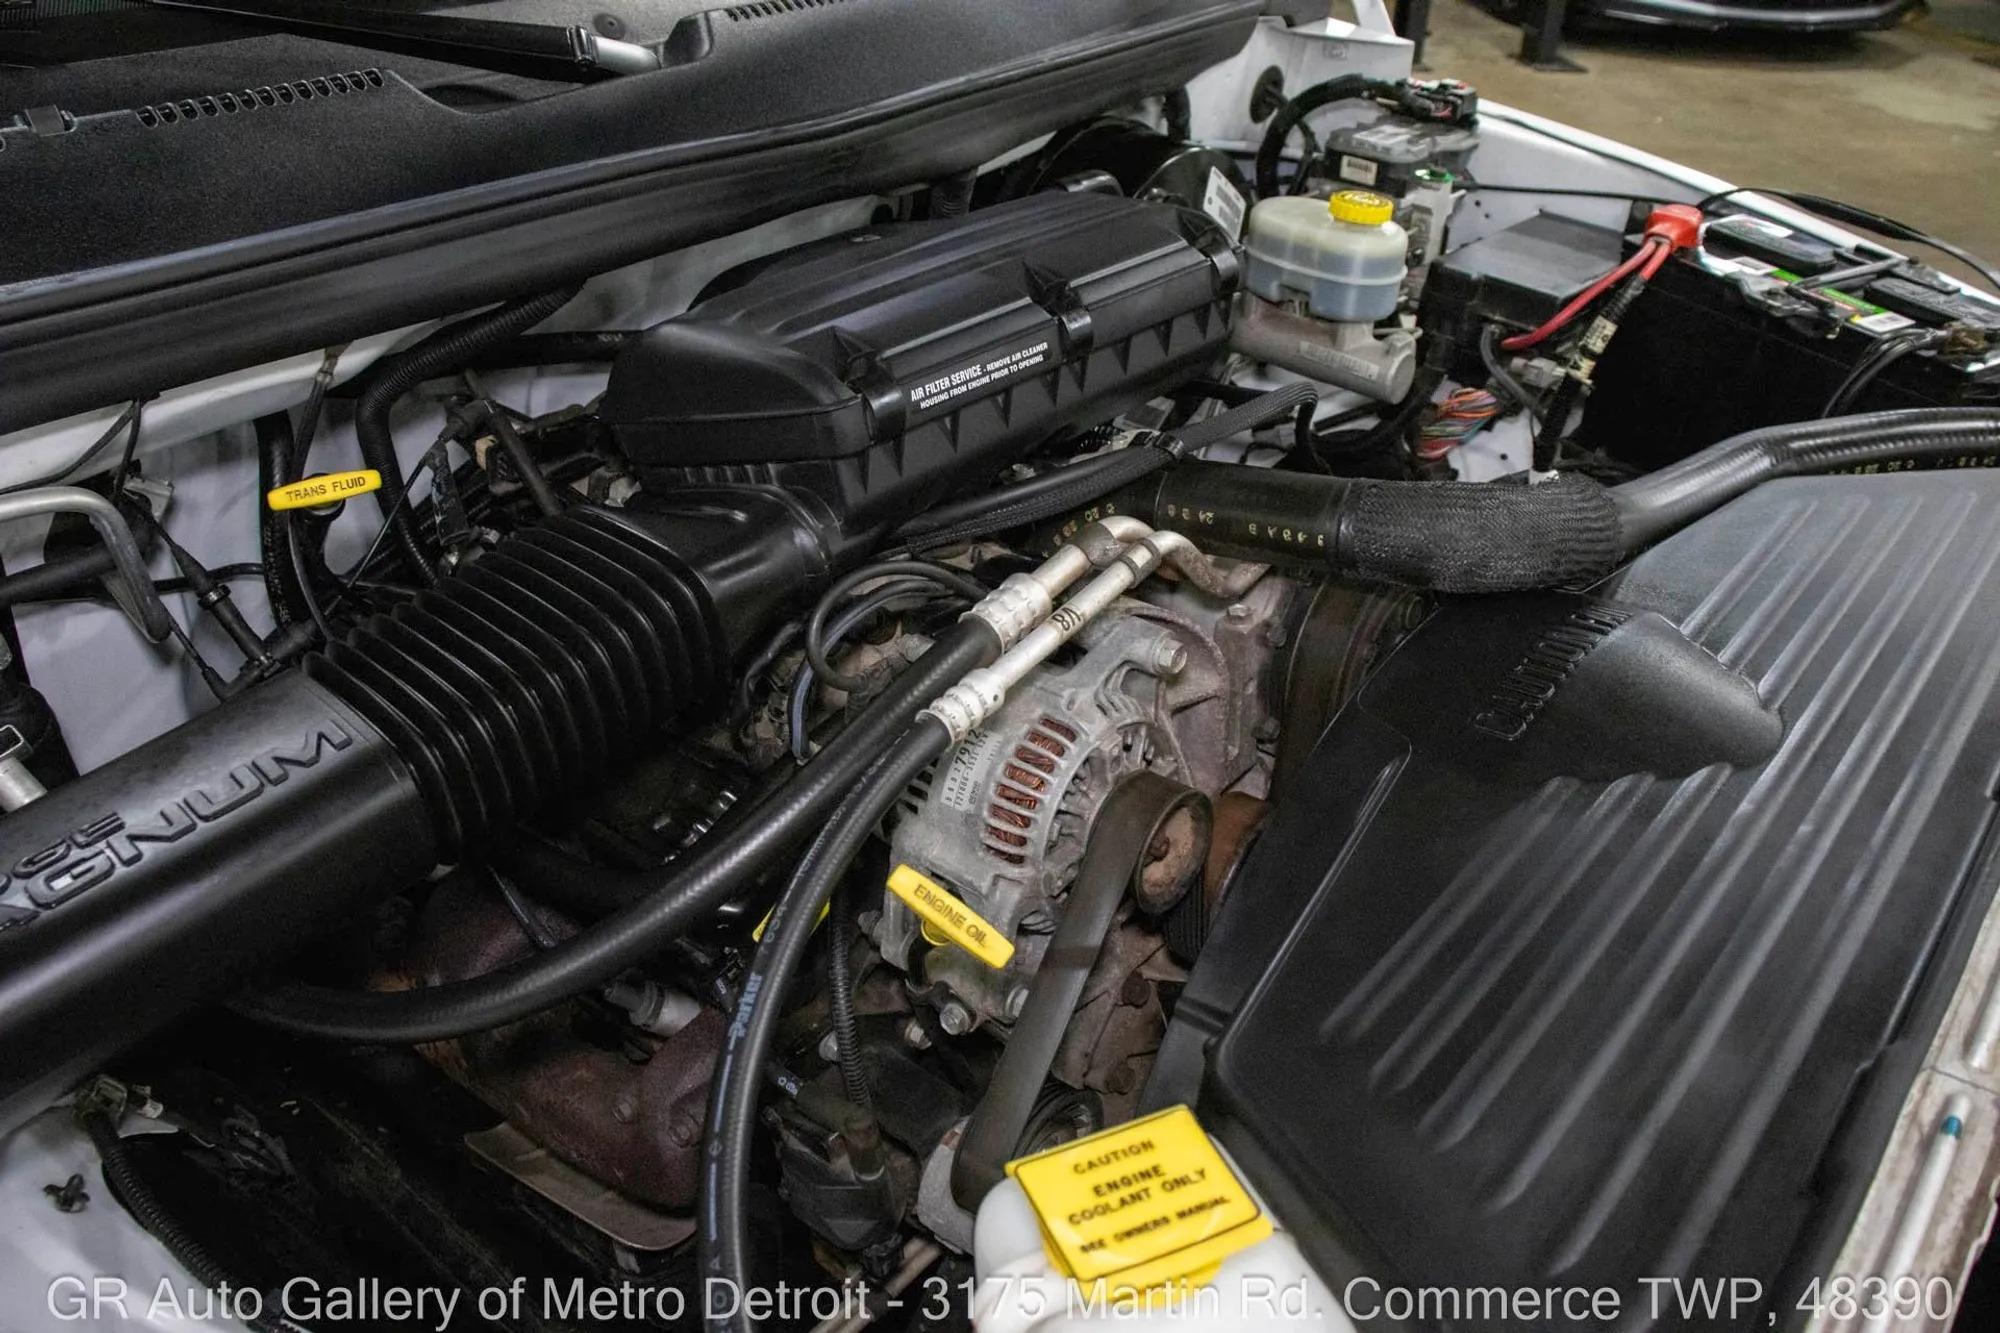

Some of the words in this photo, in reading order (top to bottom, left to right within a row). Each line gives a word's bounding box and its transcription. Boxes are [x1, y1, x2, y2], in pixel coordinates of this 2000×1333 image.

[910, 389, 924, 402] AIR
[925, 376, 951, 395] FILTER
[951, 364, 982, 386] SERVICE
[986, 358, 1011, 372] REMOVE
[1011, 351, 1022, 362] AIR
[1021, 341, 1048, 358] CLEANER
[920, 393, 949, 410] HOUSING
[949, 385, 968, 398] FROM
[968, 375, 990, 390] ENGINE
[990, 369, 1009, 381] PRIOR
[1009, 363, 1018, 373] TO
[1018, 354, 1044, 370] OPENING
[286, 484, 327, 502] TRANS
[331, 476, 366, 492] FLUID
[913, 883, 967, 929] ENGINE
[965, 924, 988, 948] OIL
[1073, 1139, 1155, 1175] CAUTION
[1093, 1164, 1165, 1197] ENGINE
[1068, 1189, 1151, 1226] COOLANT
[1161, 1168, 1207, 1192] ONLY
[1080, 1238, 1107, 1254] SEE
[1113, 1215, 1171, 1242] OWNERS
[1176, 1196, 1231, 1220] MANUAL
